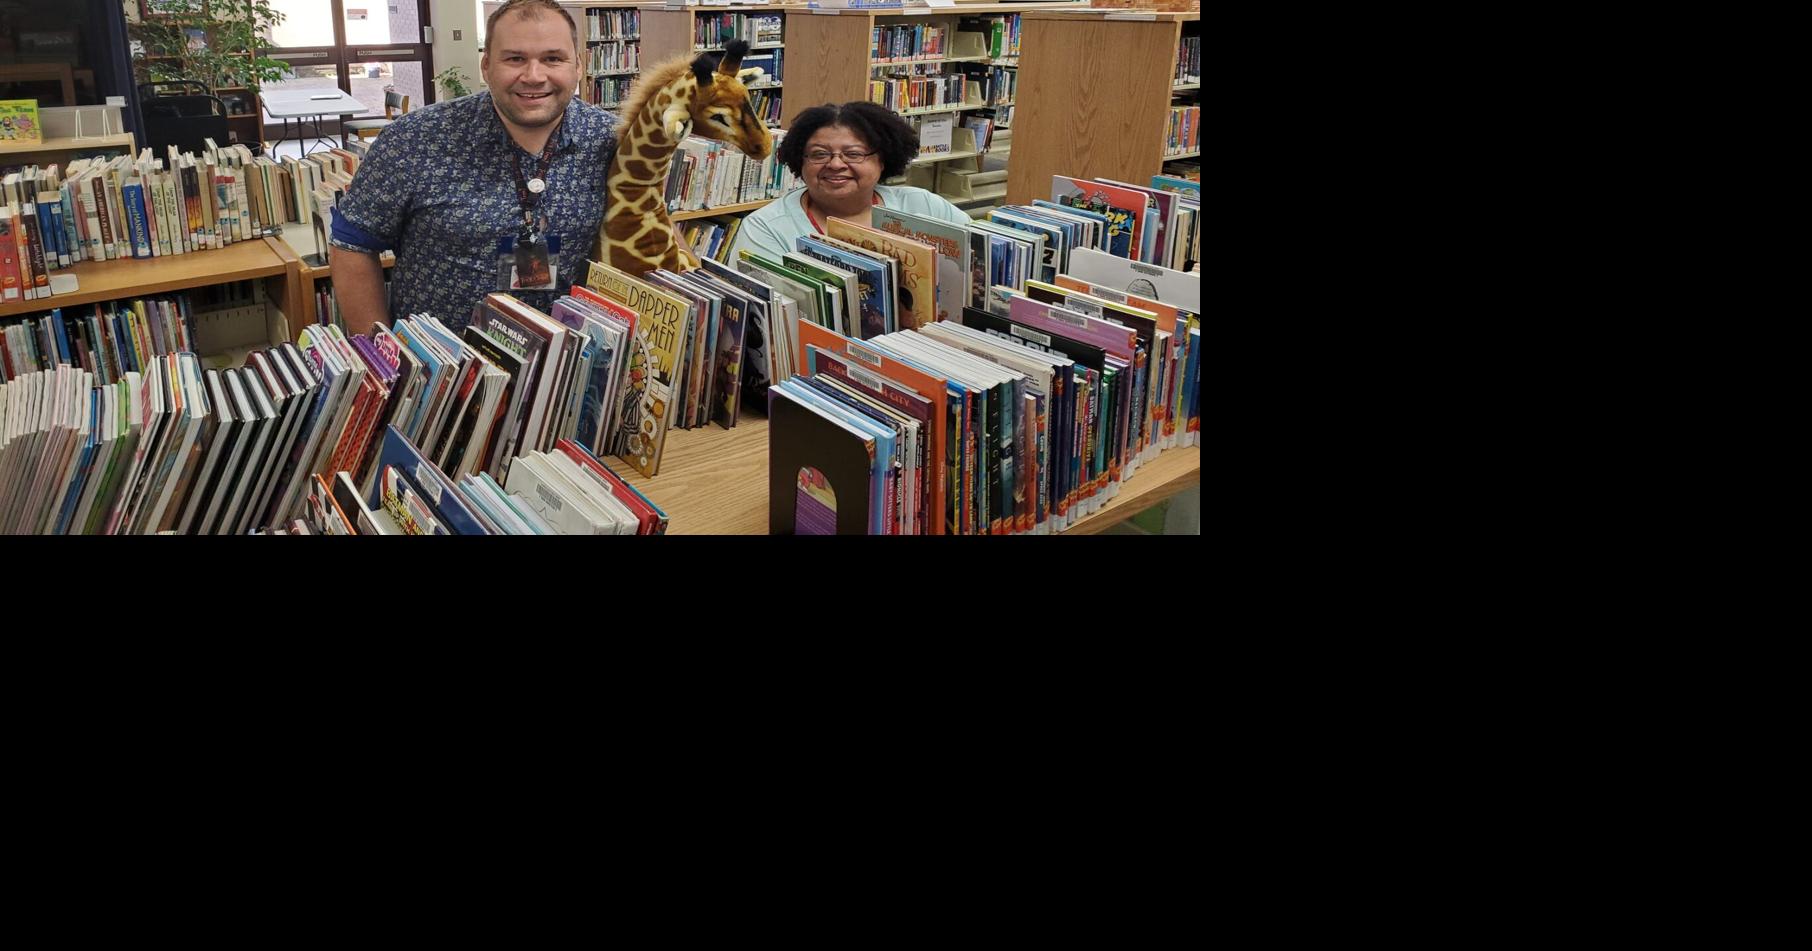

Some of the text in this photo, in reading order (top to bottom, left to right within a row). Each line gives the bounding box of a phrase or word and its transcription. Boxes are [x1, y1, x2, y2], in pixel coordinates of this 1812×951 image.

[590, 269, 613, 290] RETURN
[628, 286, 679, 330] DAPPER
[489, 318, 528, 345] STAR WARS
[647, 322, 675, 353] MEN
